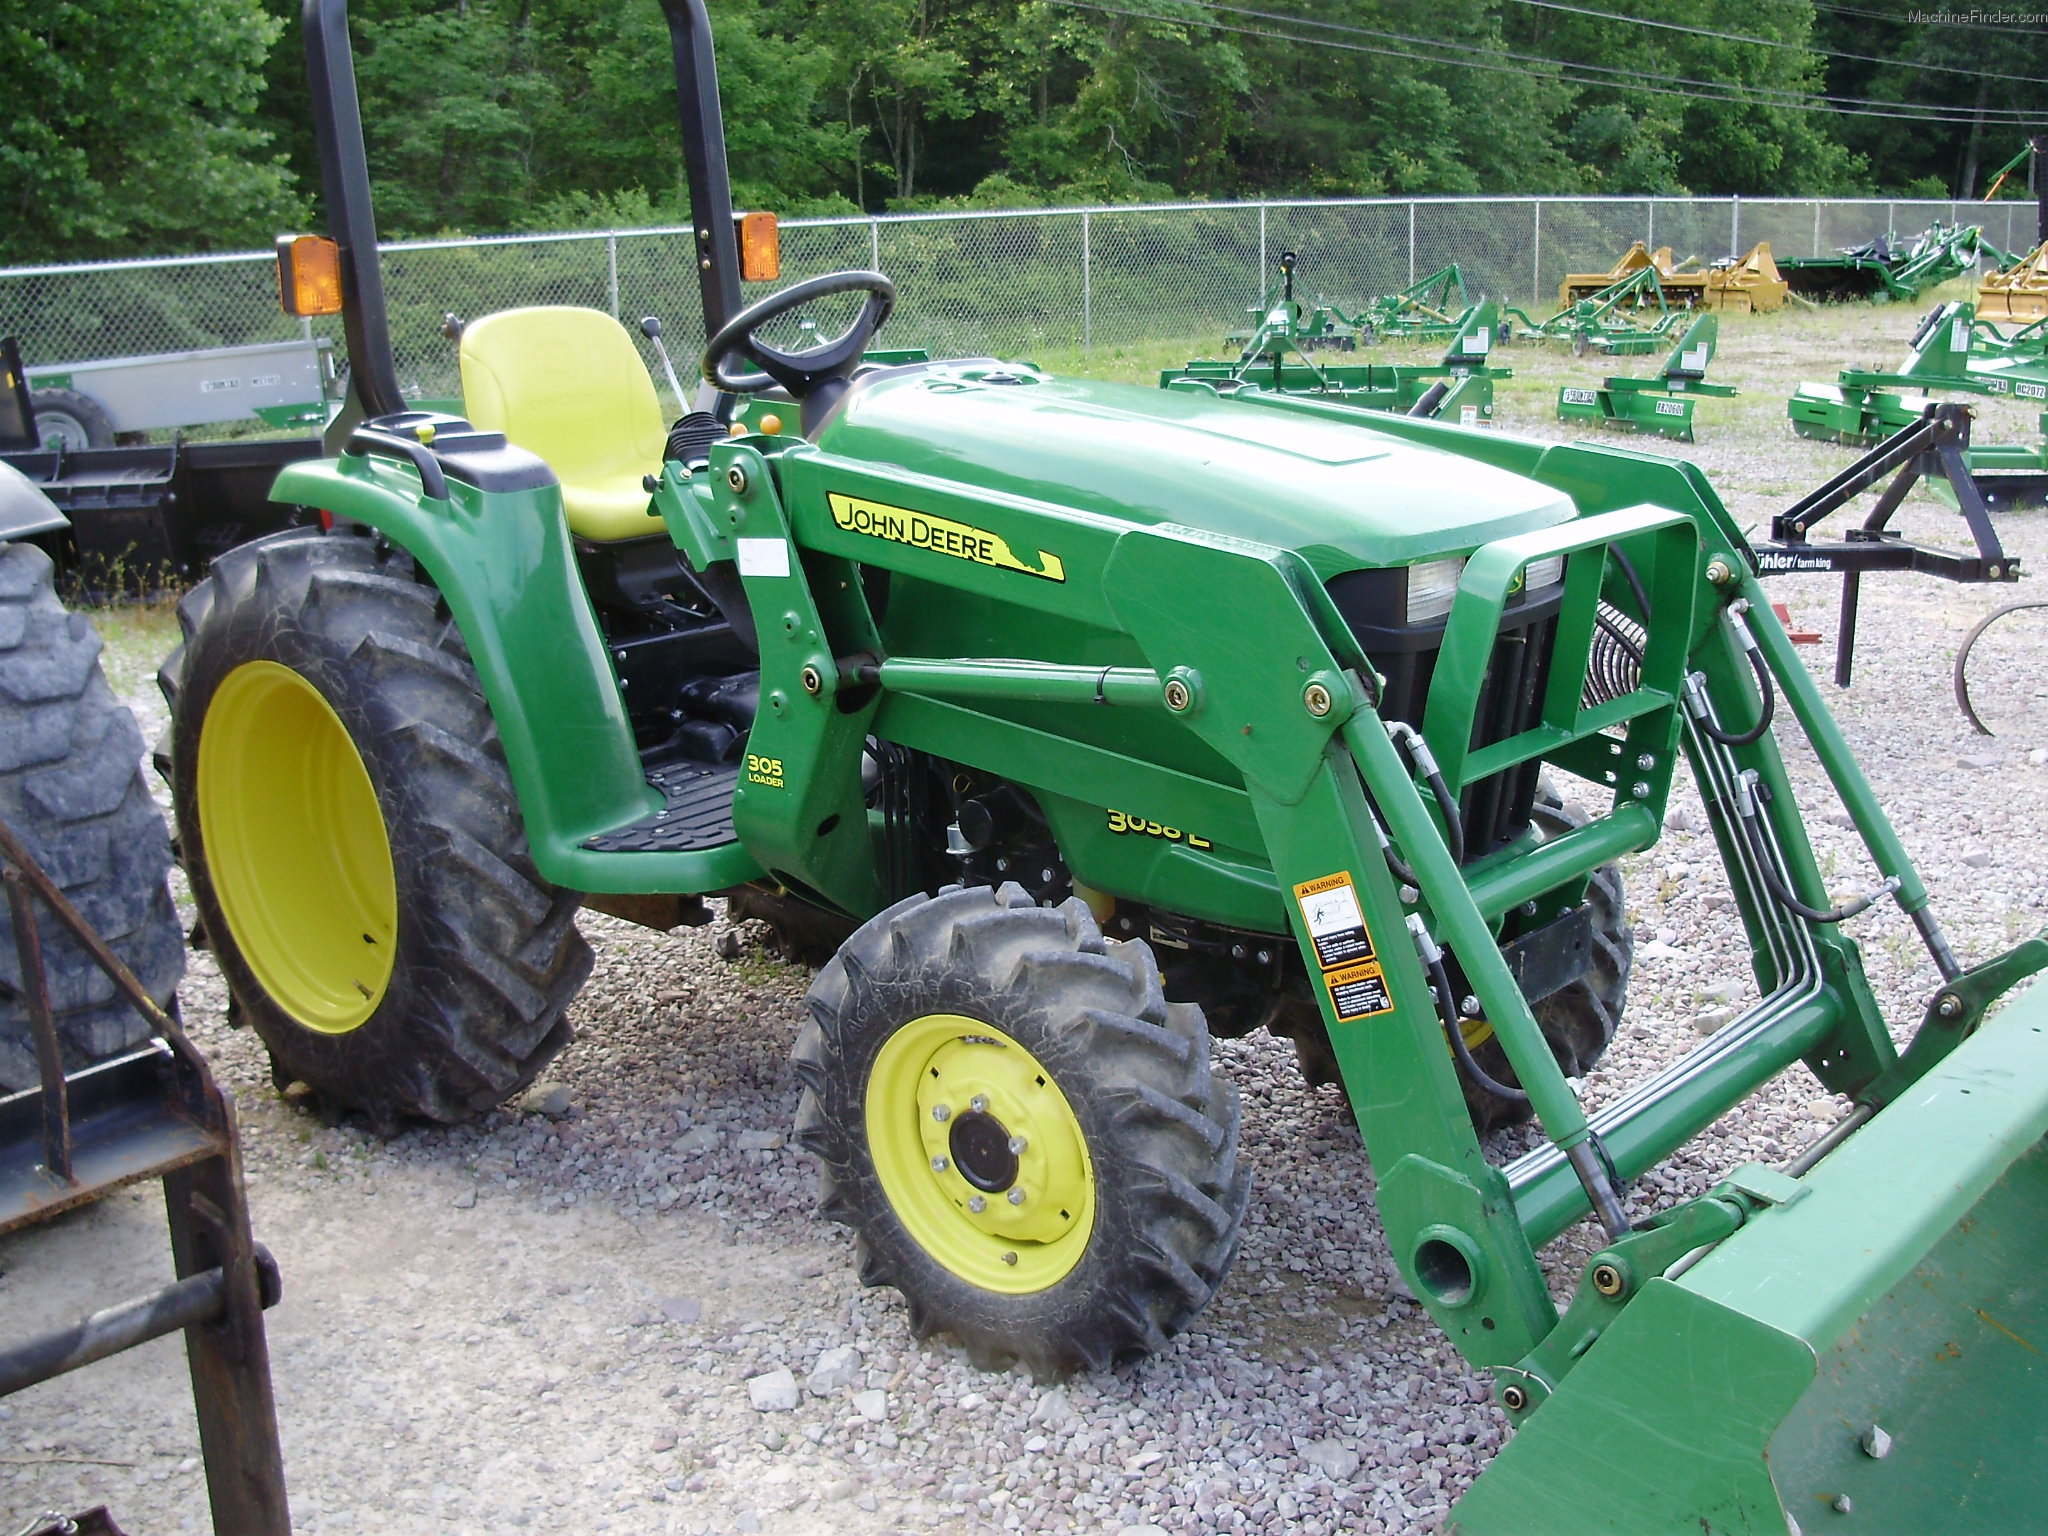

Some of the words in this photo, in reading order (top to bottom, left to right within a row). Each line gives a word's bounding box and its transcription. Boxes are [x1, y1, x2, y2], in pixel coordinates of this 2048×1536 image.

[747, 754, 783, 777] 305
[748, 772, 784, 788] LOADER
[1308, 876, 1344, 892] WARNING
[1339, 967, 1376, 981] WARNING
